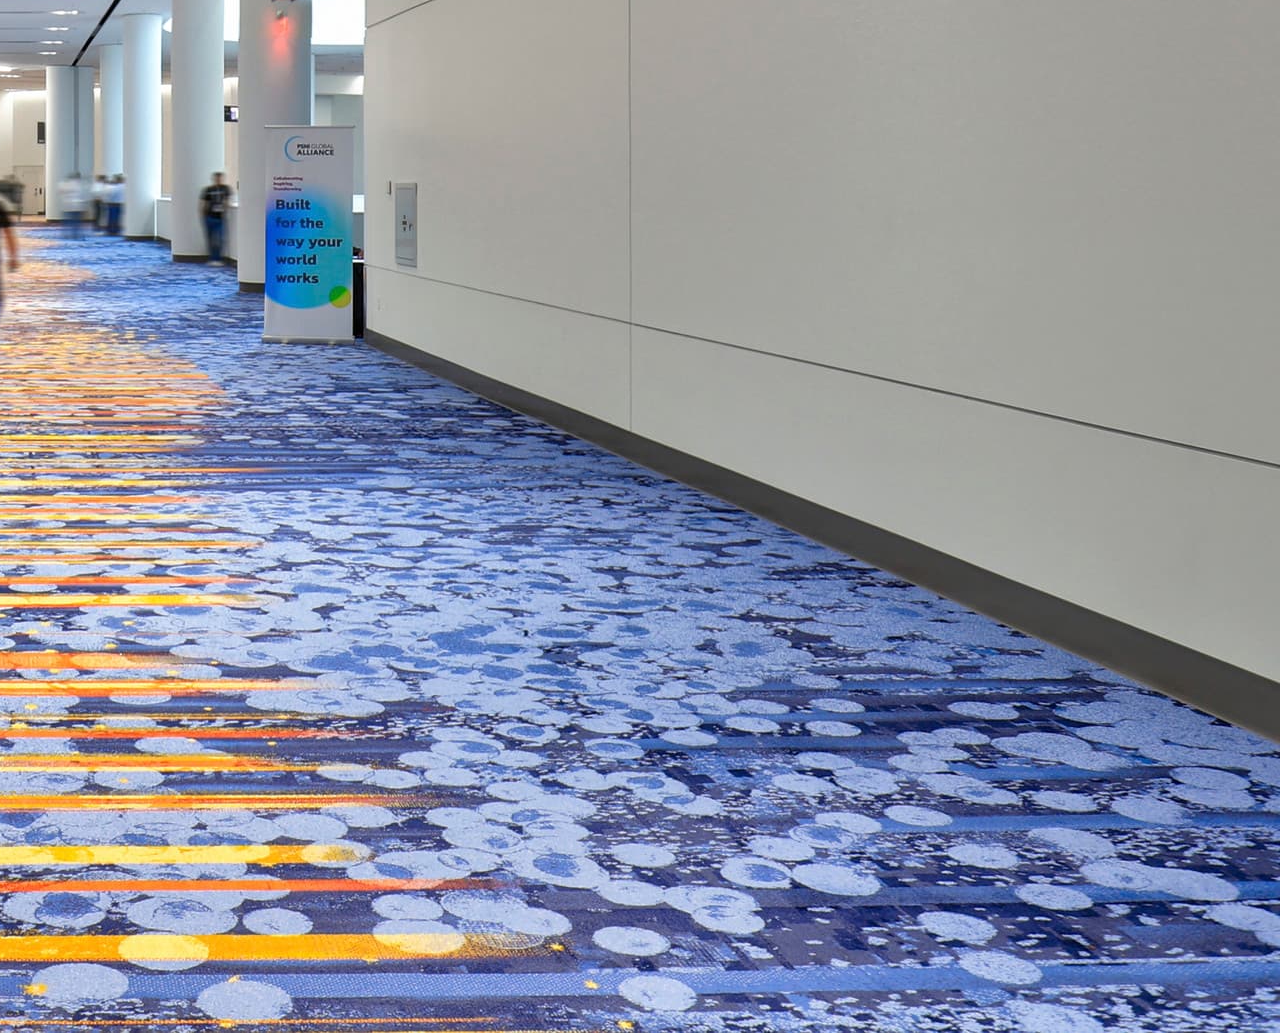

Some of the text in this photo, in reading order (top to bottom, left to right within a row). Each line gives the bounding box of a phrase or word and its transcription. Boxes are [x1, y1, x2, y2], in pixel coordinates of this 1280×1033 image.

[276, 199, 311, 210] Built
[276, 217, 324, 229] for the
[276, 238, 343, 249] way your
[276, 254, 317, 265] world
[276, 272, 319, 284] works
